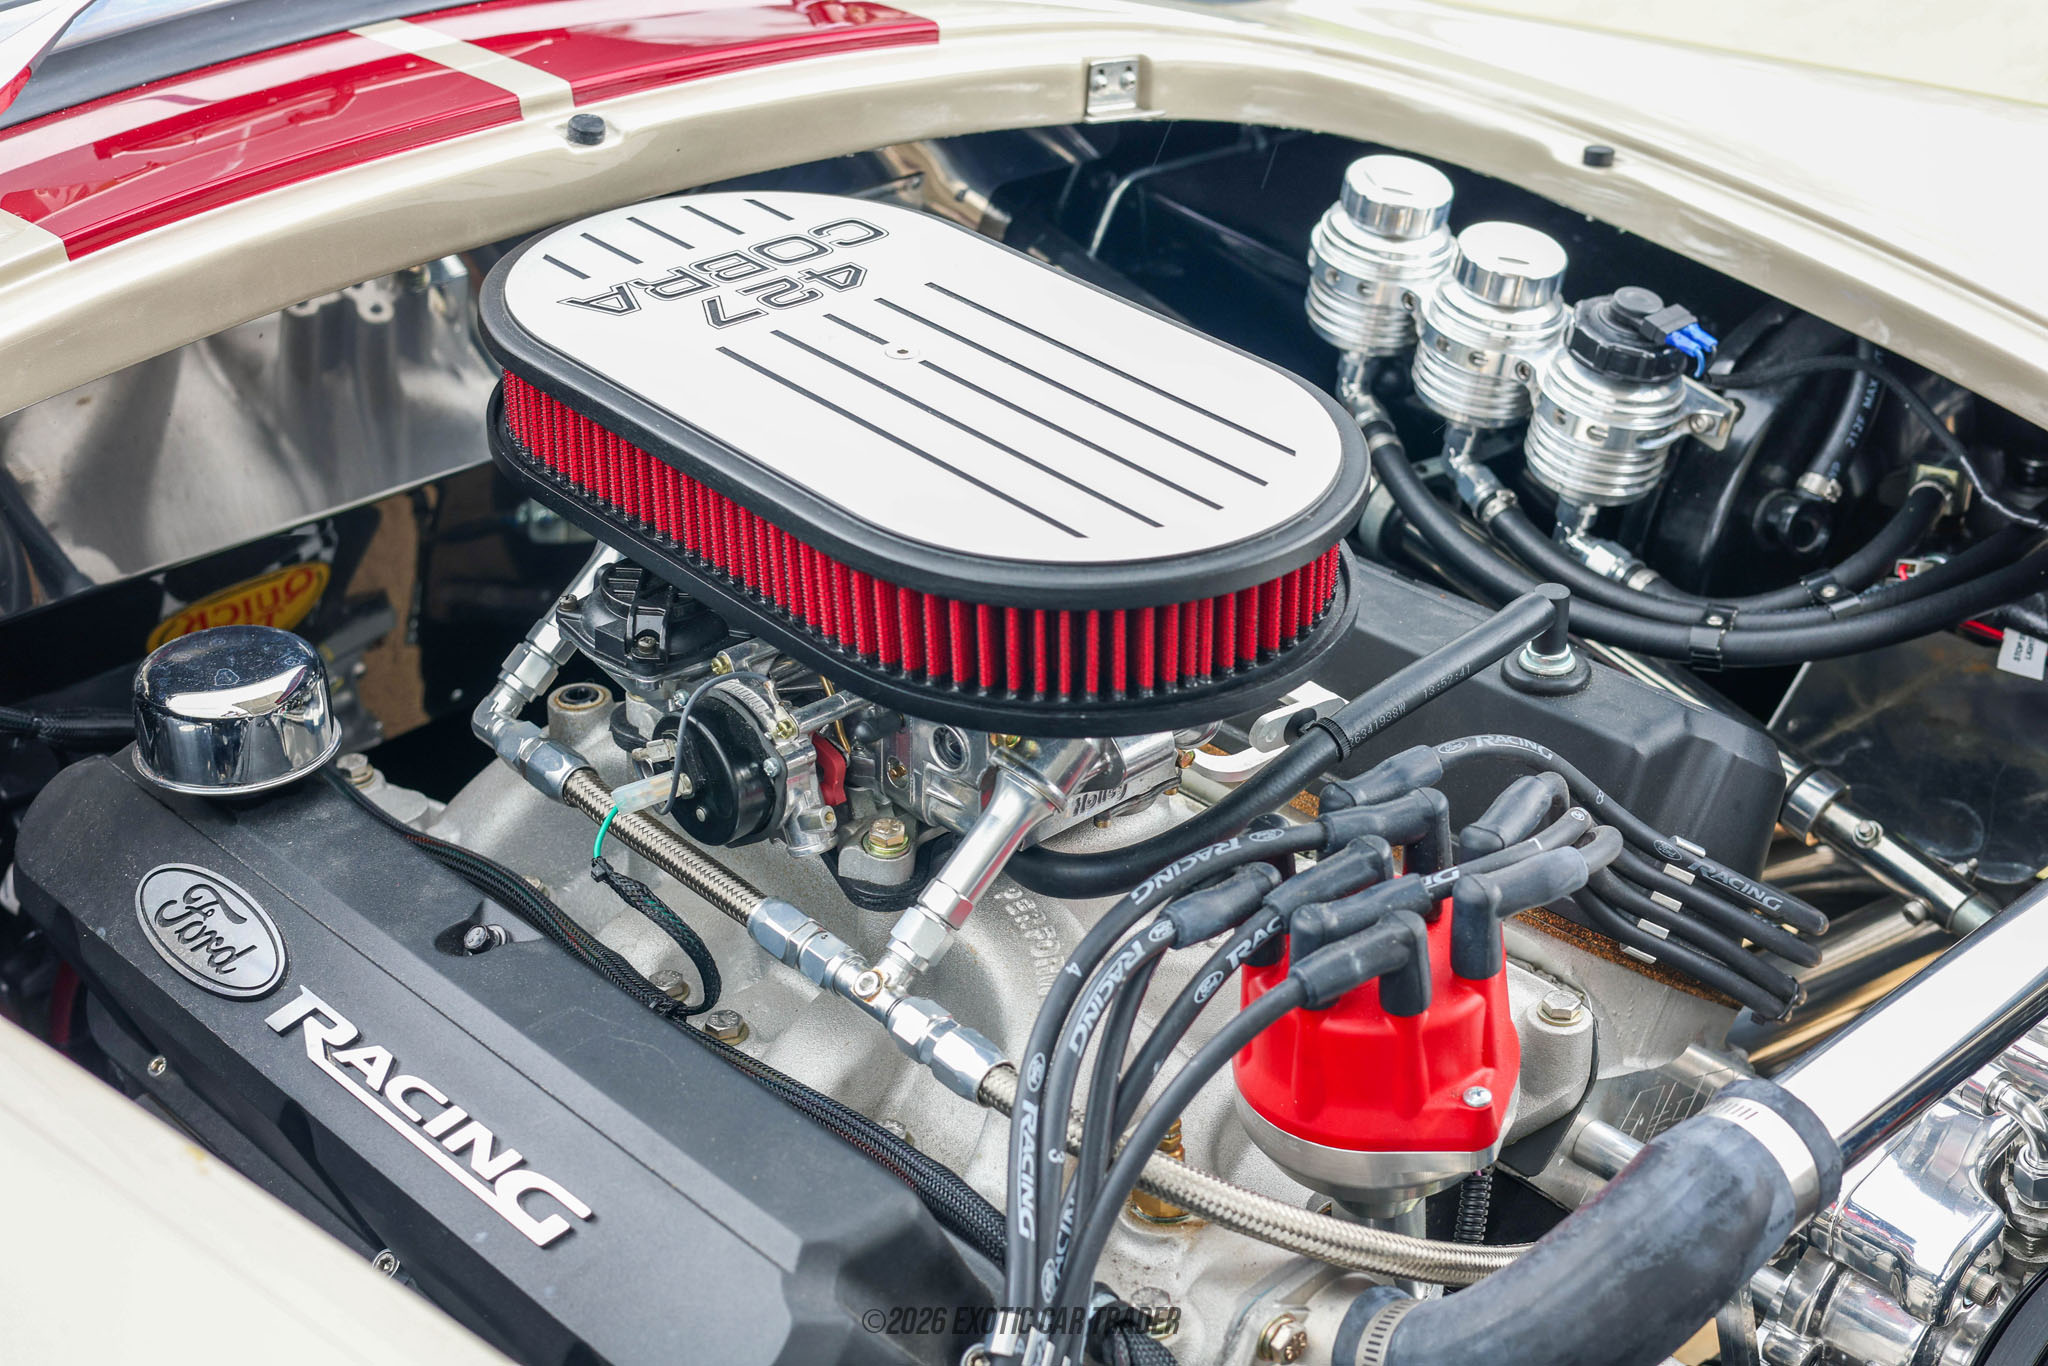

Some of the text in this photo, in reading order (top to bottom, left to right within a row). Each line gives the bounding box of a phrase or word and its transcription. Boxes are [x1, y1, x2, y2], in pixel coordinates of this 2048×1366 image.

[556, 218, 889, 316] COBRA
[701, 261, 868, 330] 427
[1472, 735, 1553, 760] RACING
[1595, 789, 1605, 805] 8
[1130, 837, 1242, 905] RACING
[1688, 861, 1784, 911] RACING
[154, 883, 257, 975] Ford
[1065, 961, 1082, 978] 4
[1068, 940, 1146, 1057] RACING
[264, 985, 594, 1248] RACING
[1017, 1099, 1039, 1242] RACING
[1047, 1148, 1065, 1164] 3
